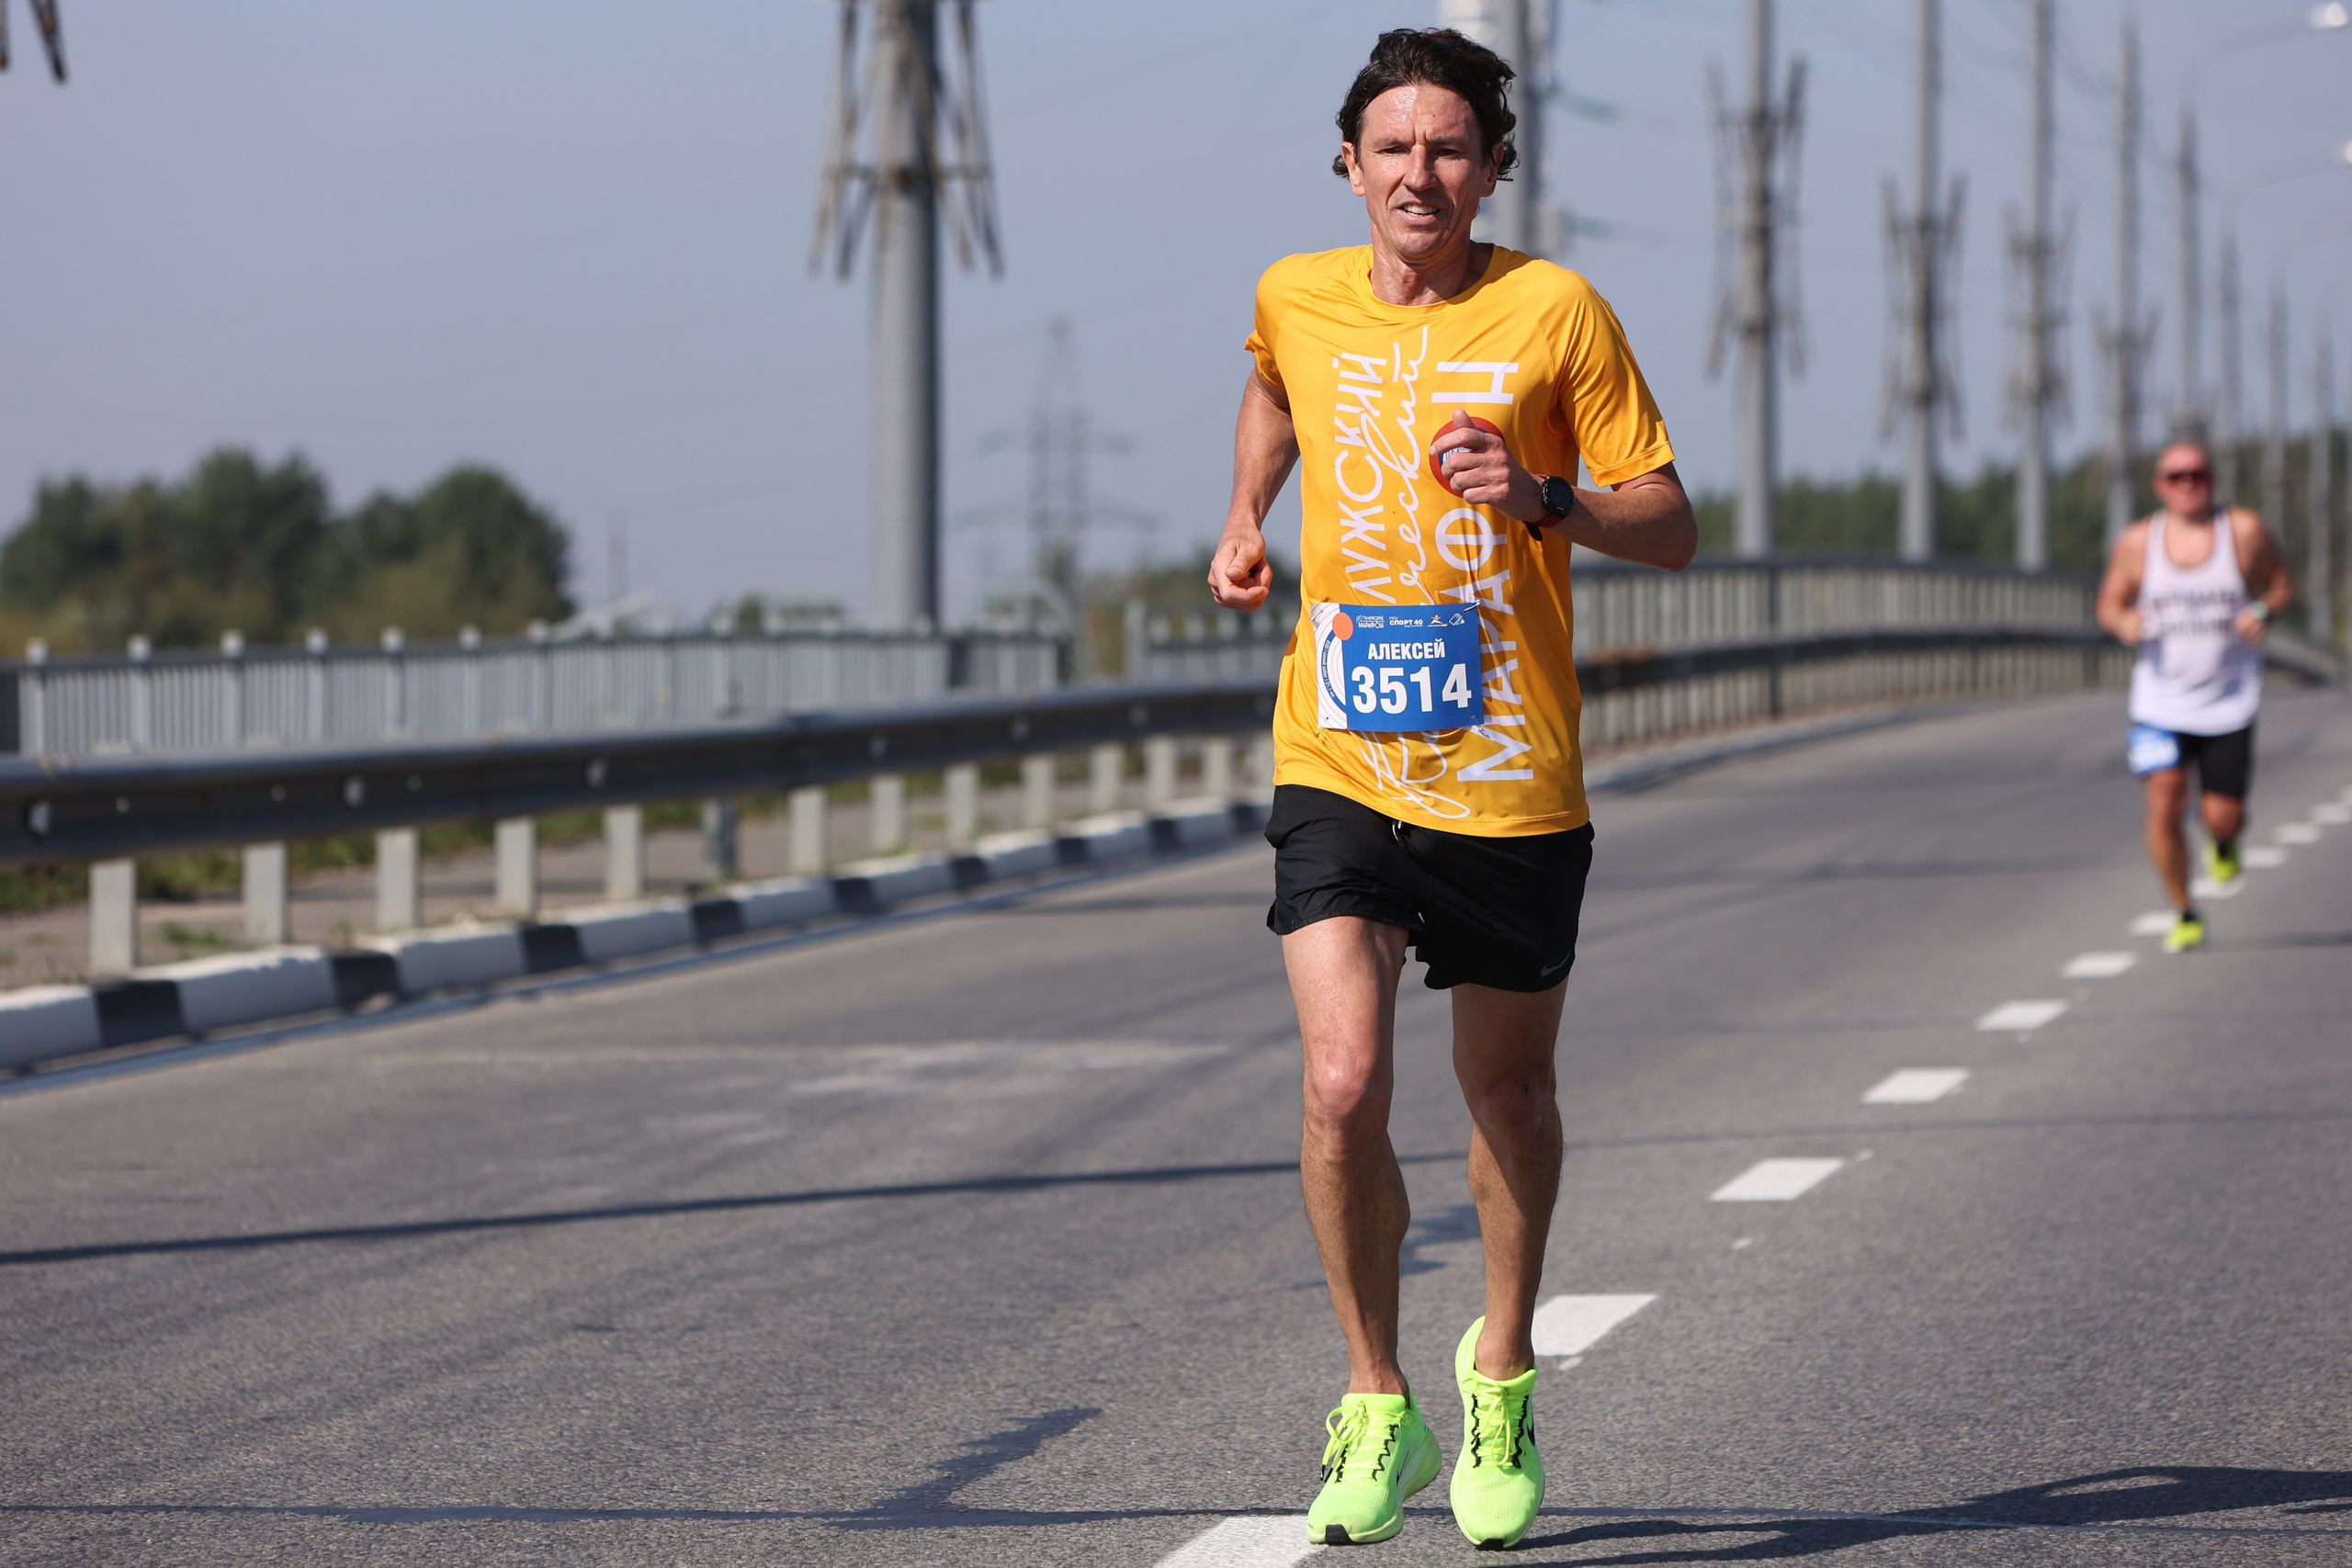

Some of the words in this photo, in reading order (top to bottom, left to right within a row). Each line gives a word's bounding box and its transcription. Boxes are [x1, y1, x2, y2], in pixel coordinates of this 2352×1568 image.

[1332, 353, 1396, 604] ЛУЖСКИЙ
[1368, 638, 1445, 660] АЛЕКСЕЙ
[1351, 663, 1472, 715] 3514
